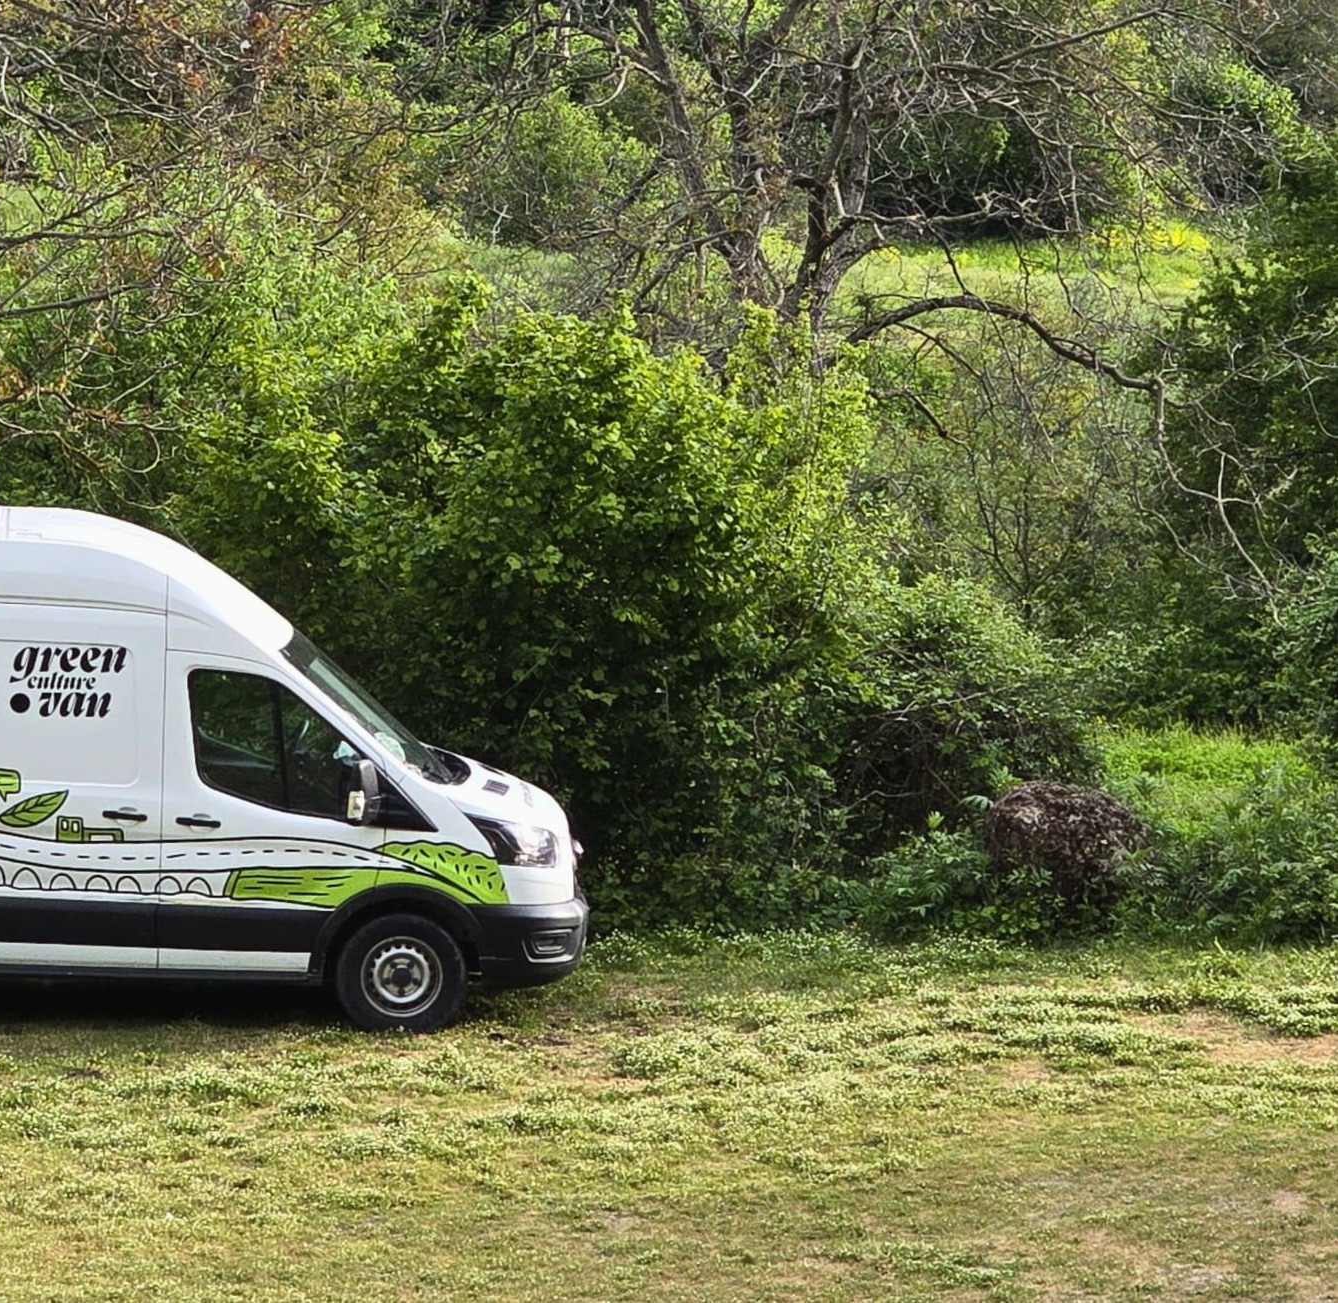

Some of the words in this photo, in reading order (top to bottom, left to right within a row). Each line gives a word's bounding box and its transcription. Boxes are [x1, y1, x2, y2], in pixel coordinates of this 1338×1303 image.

[9, 646, 127, 683] green
[27, 672, 96, 690] culture
[39, 692, 111, 718] van
